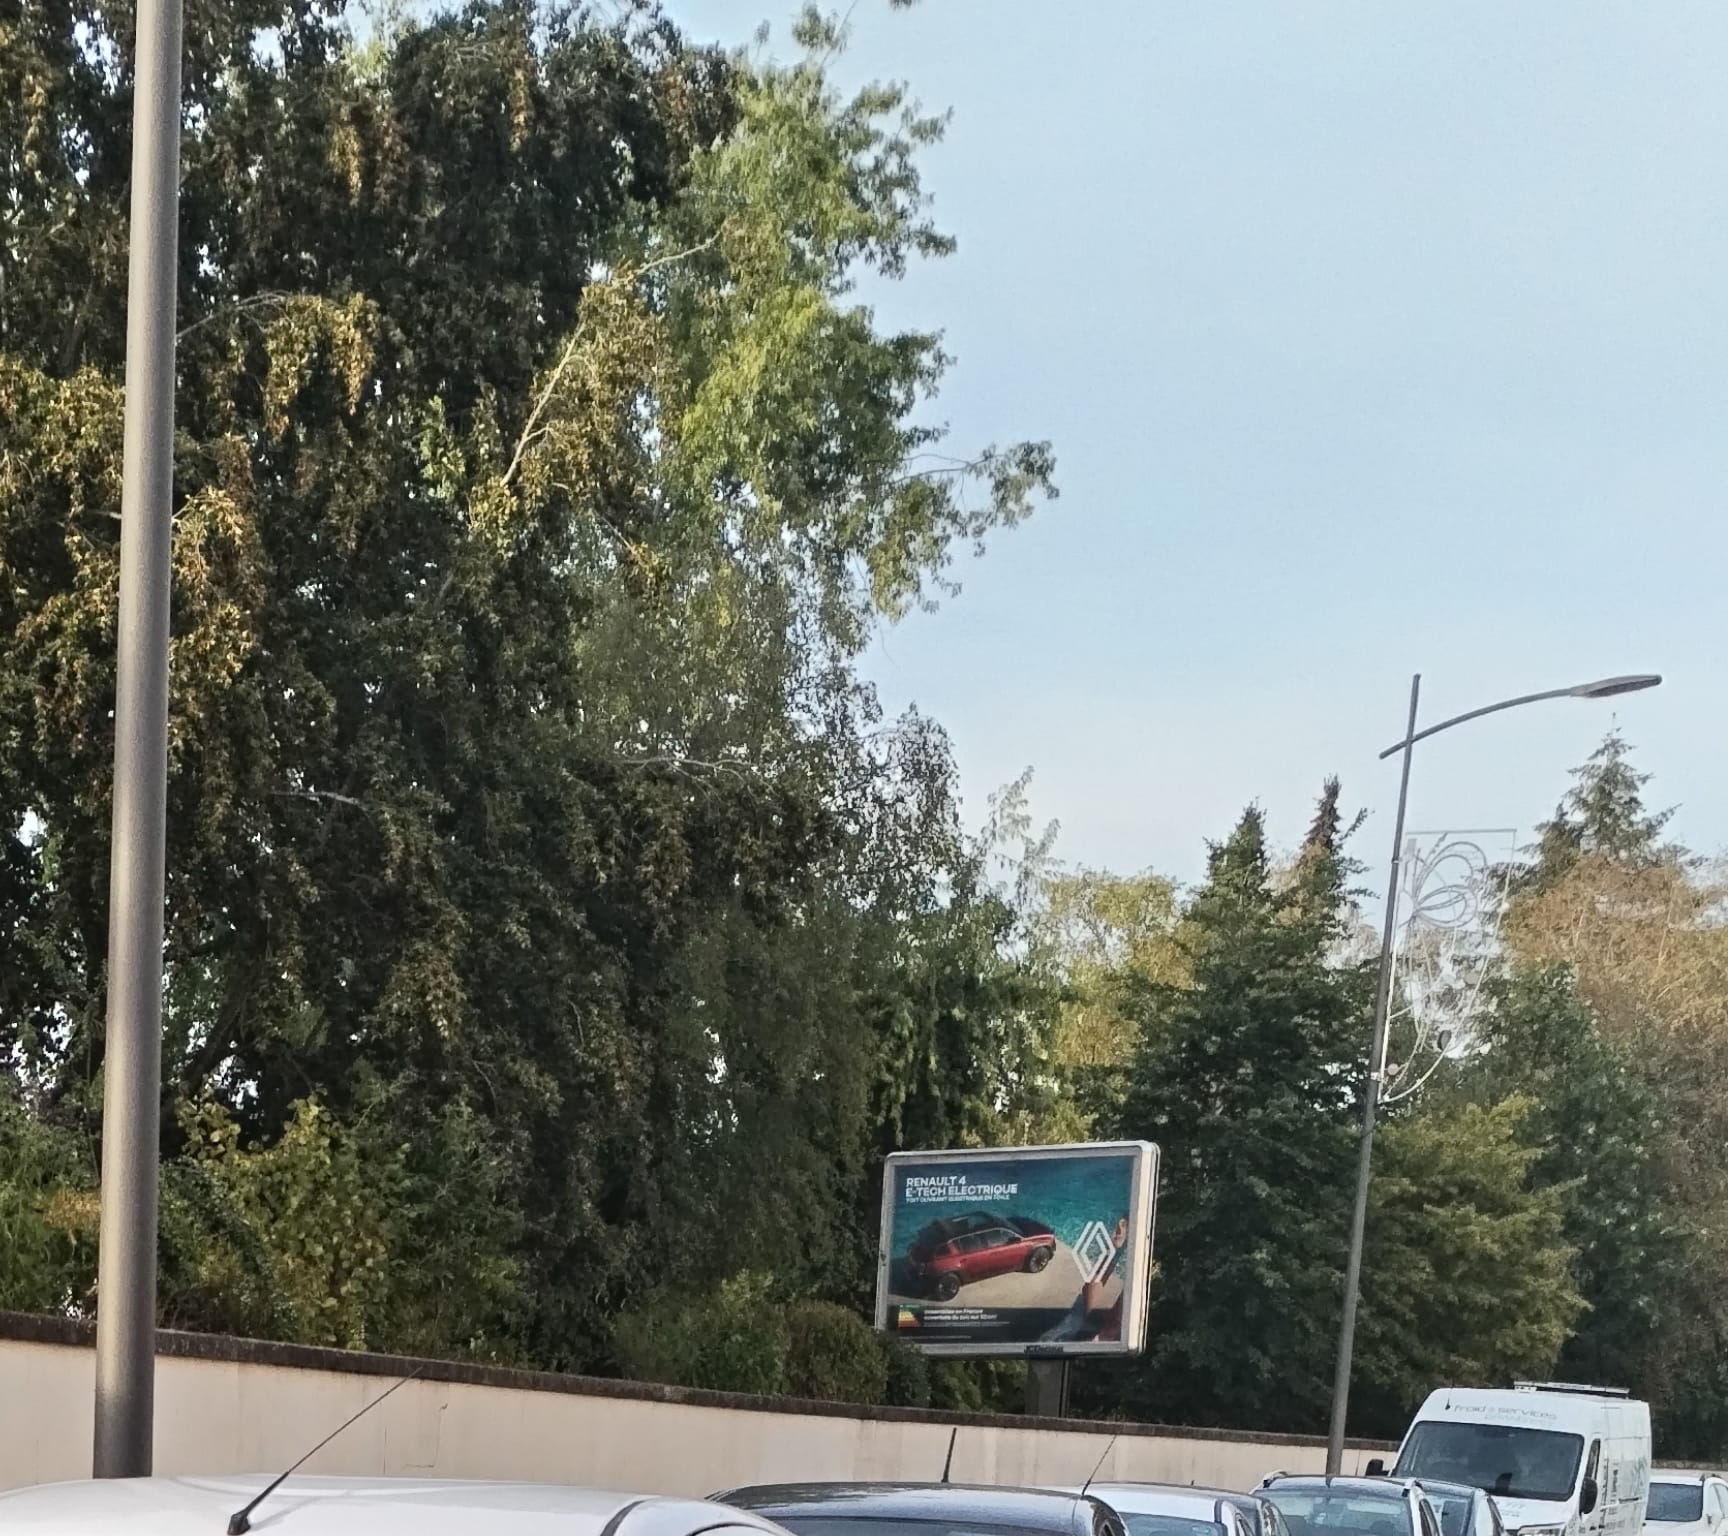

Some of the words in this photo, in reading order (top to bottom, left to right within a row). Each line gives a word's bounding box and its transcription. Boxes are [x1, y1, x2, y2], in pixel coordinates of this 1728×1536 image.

[906, 1176, 957, 1187] RENAULT
[958, 1175, 967, 1185] 4
[905, 1187, 946, 1197] E-TECH
[948, 1183, 1018, 1196] ELECTRIQUE
